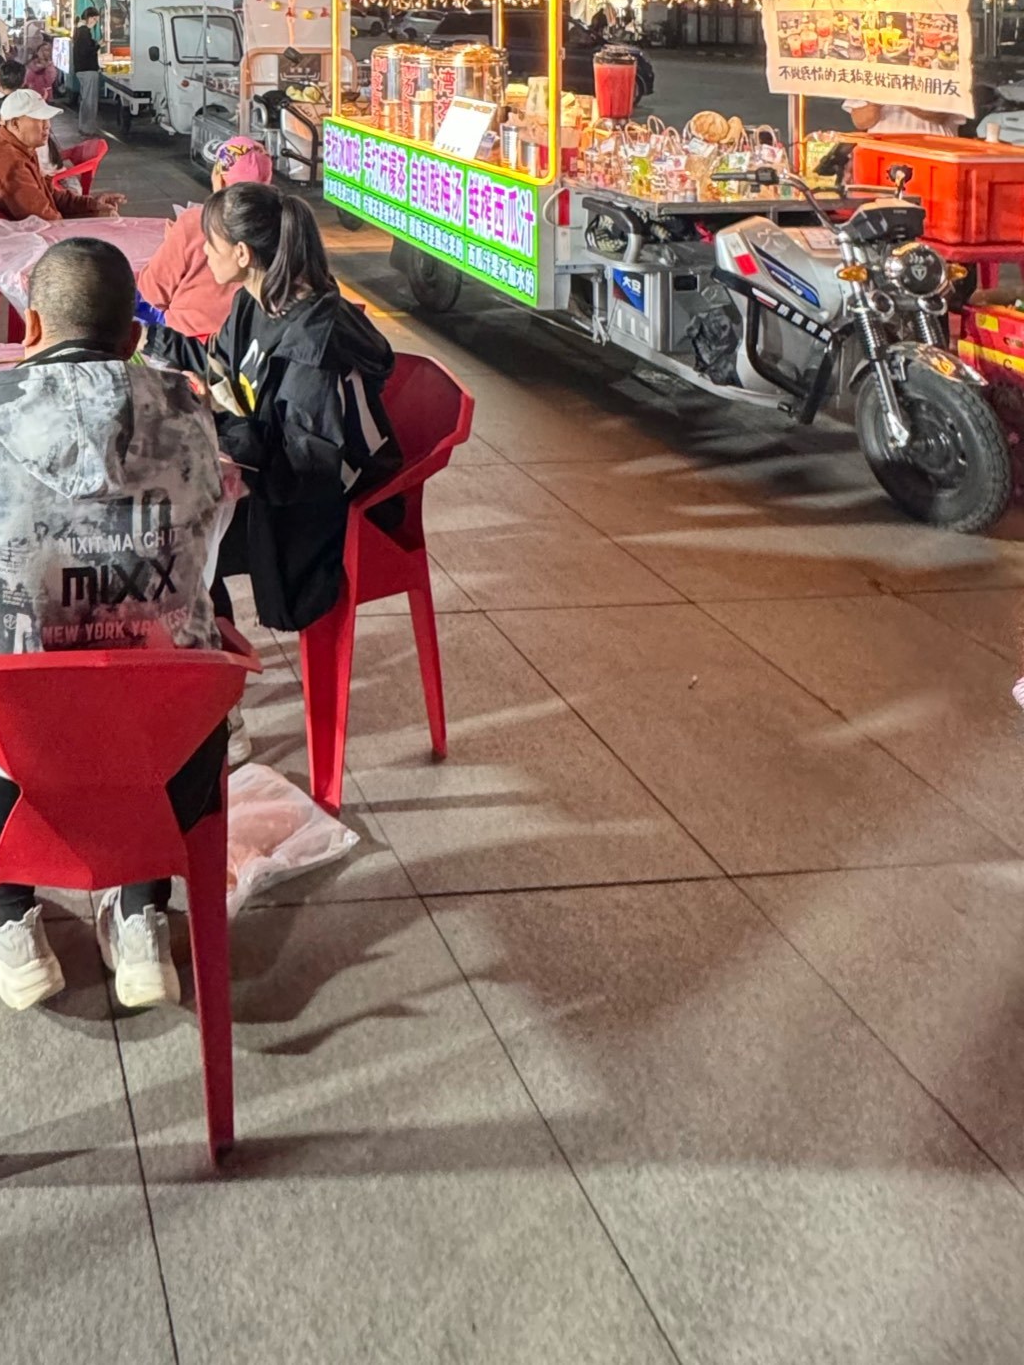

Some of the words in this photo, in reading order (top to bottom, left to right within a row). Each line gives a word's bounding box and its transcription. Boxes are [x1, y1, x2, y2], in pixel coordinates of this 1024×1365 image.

[467, 170, 535, 258] 鲜榨西瓜汁
[42, 625, 79, 644] NEW
[85, 621, 125, 641] YORK
